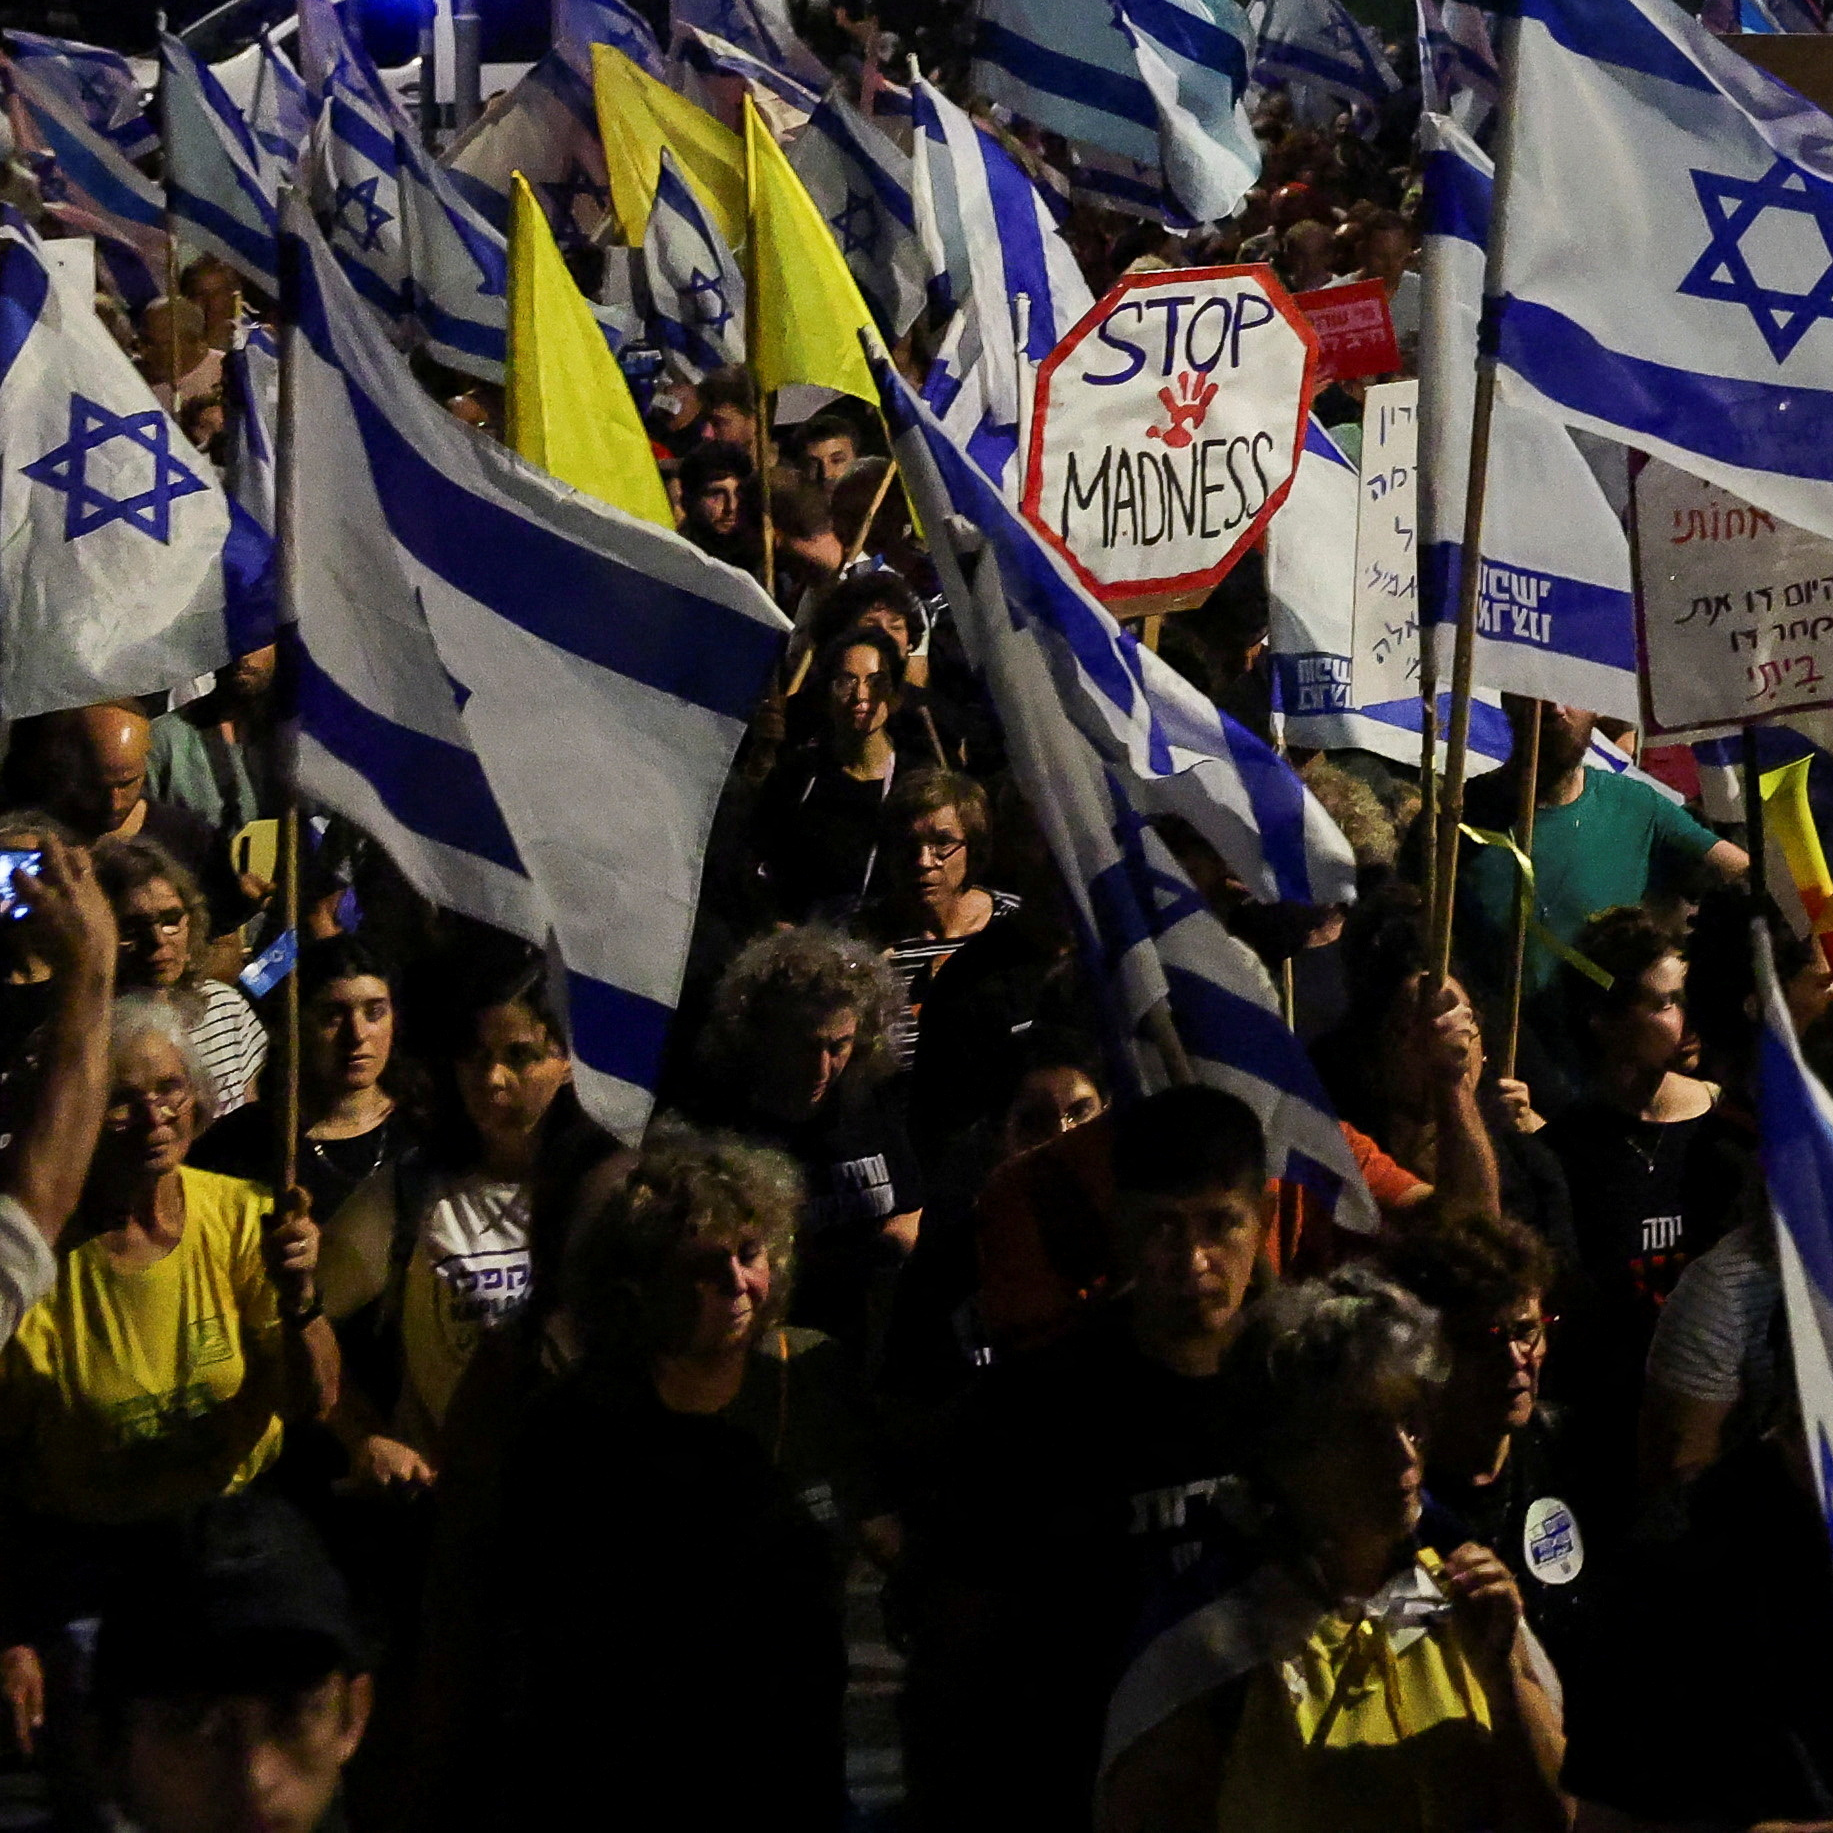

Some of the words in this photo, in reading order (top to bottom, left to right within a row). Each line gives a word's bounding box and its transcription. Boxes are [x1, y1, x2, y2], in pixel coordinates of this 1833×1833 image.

[1082, 292, 1275, 386] STOP
[1060, 430, 1274, 549] MADNESS
[1674, 594, 1732, 626] את
